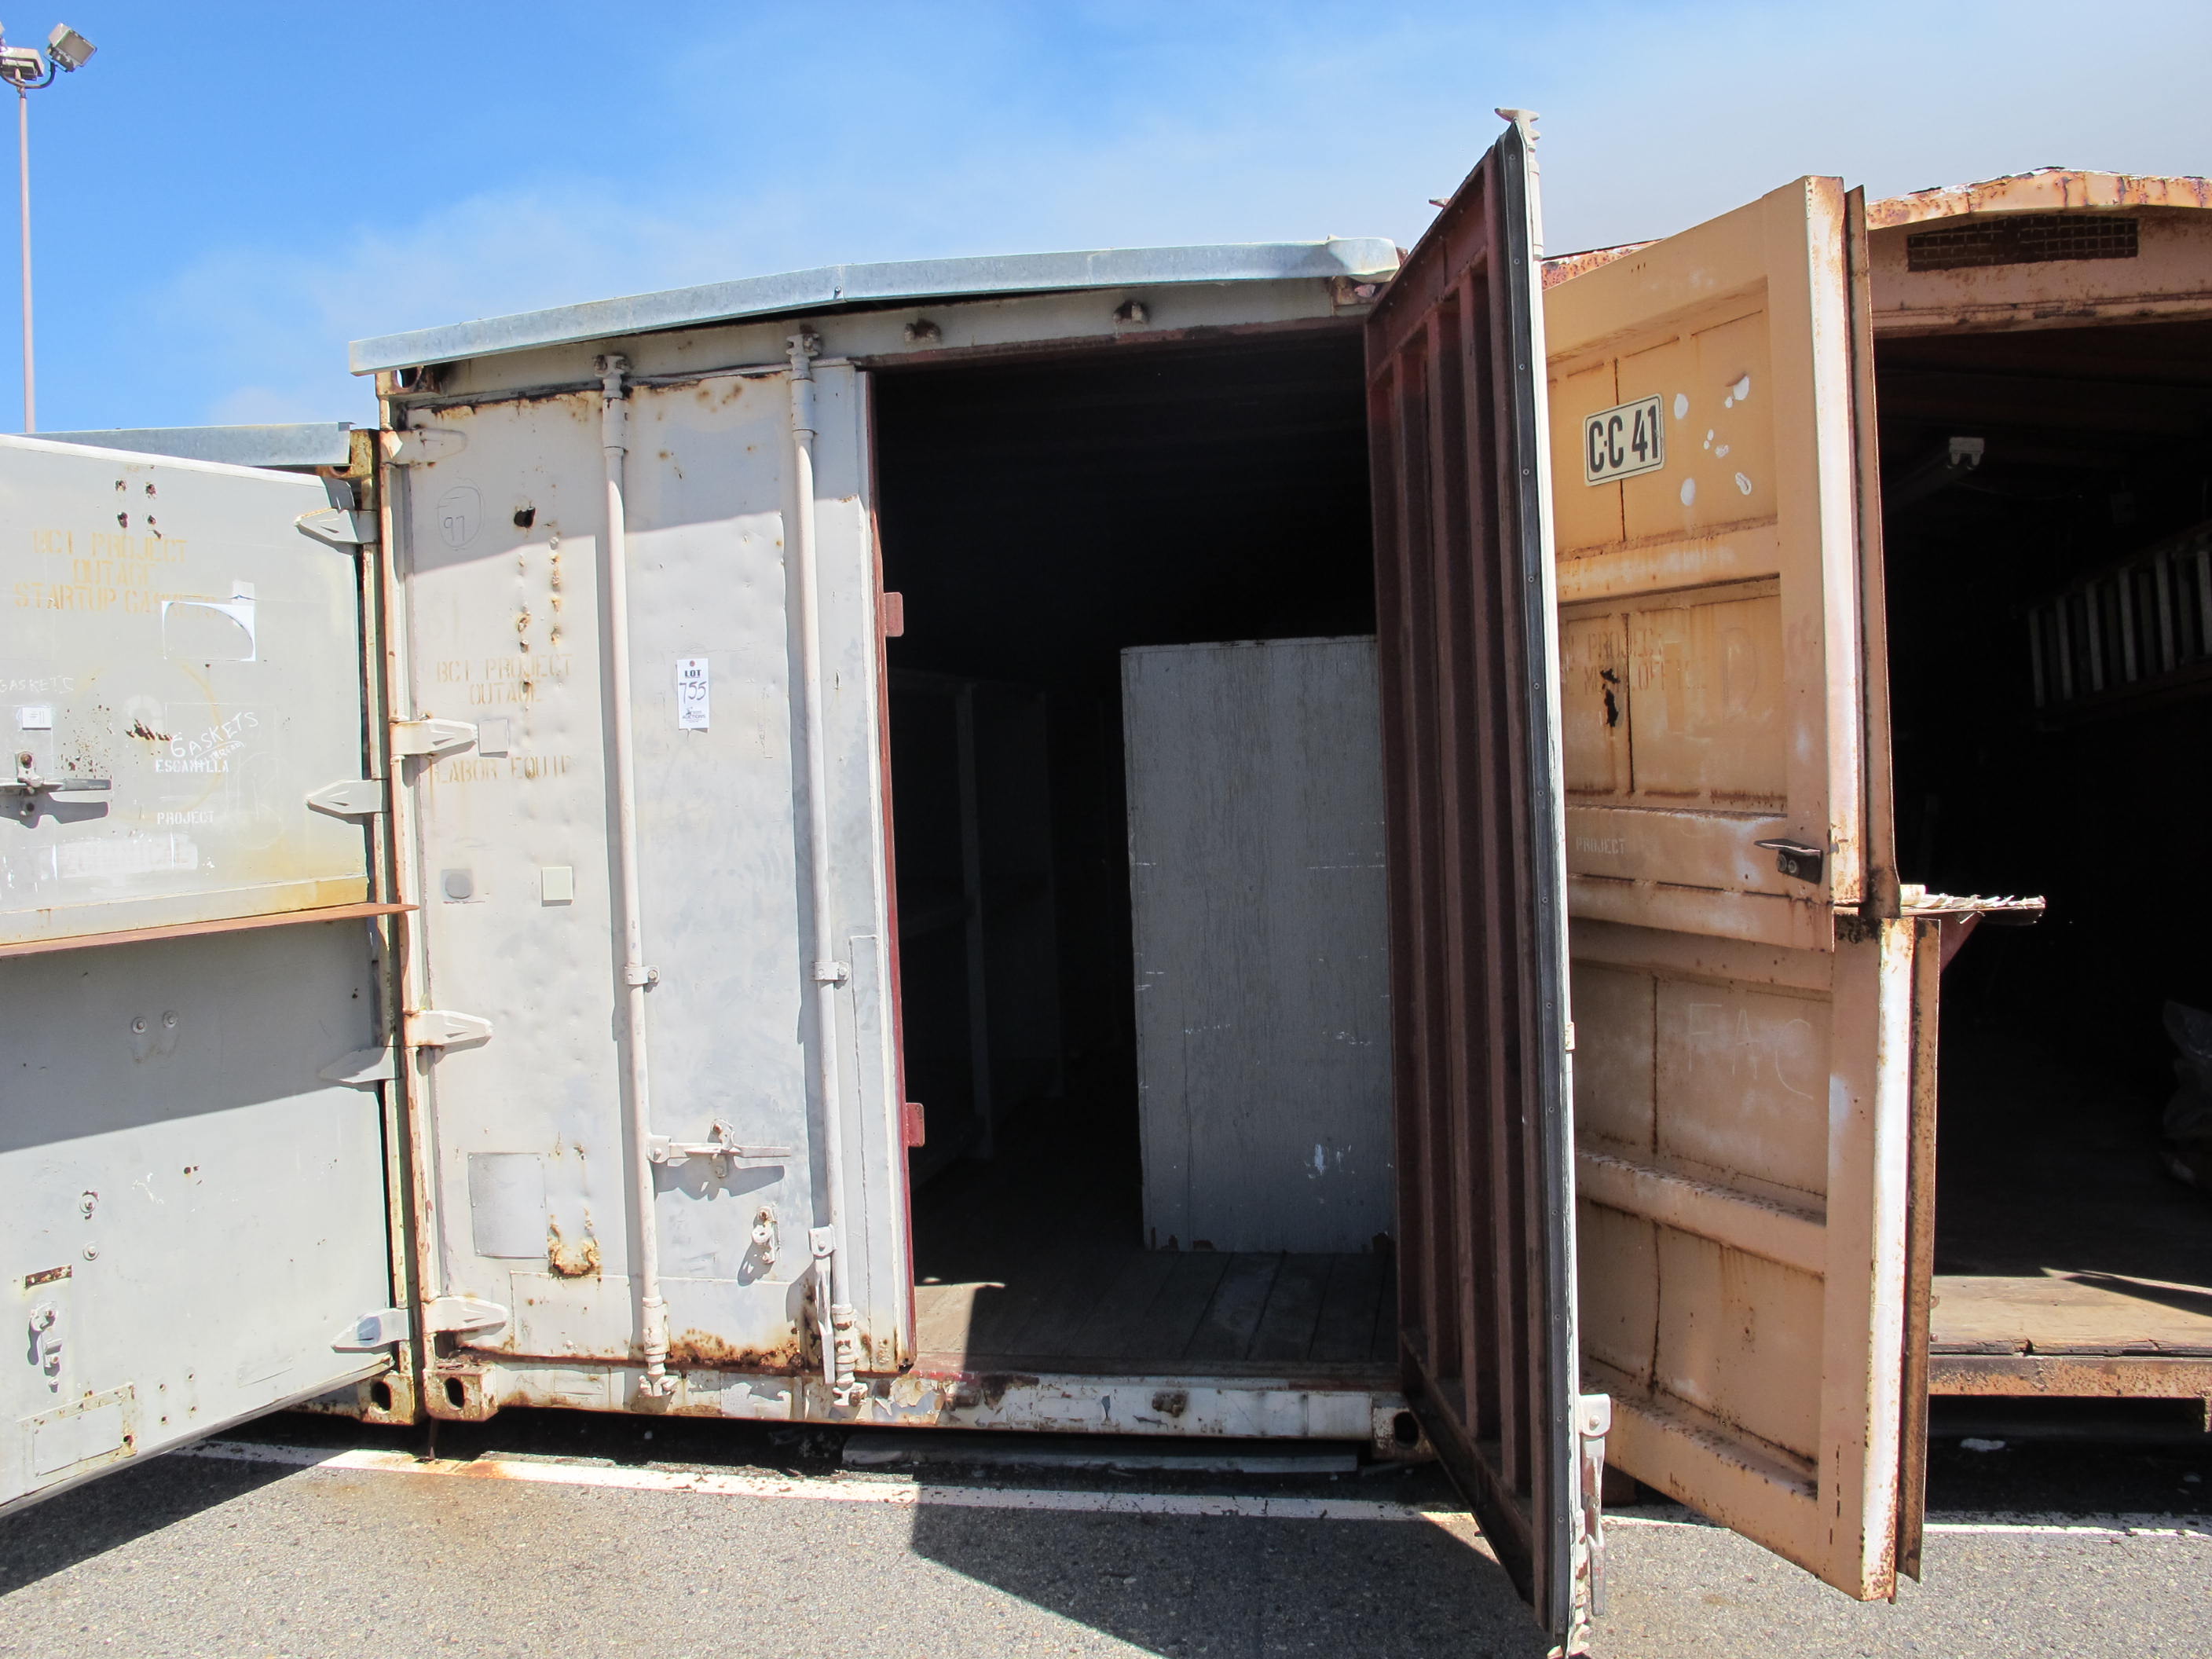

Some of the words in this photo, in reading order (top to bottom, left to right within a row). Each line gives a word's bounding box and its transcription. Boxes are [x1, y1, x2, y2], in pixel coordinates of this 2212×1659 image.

[1632, 405, 1658, 463] 41
[443, 515, 465, 541] 97
[90, 531, 187, 562] PROJECT
[13, 581, 117, 610] STARTUP
[485, 654, 573, 680] PROJECT
[684, 669, 701, 678] LOT
[679, 681, 707, 704] 755
[170, 712, 259, 757] GASKETS
[157, 811, 214, 826] PROJECT
[1576, 836, 1627, 855] PROJECT
